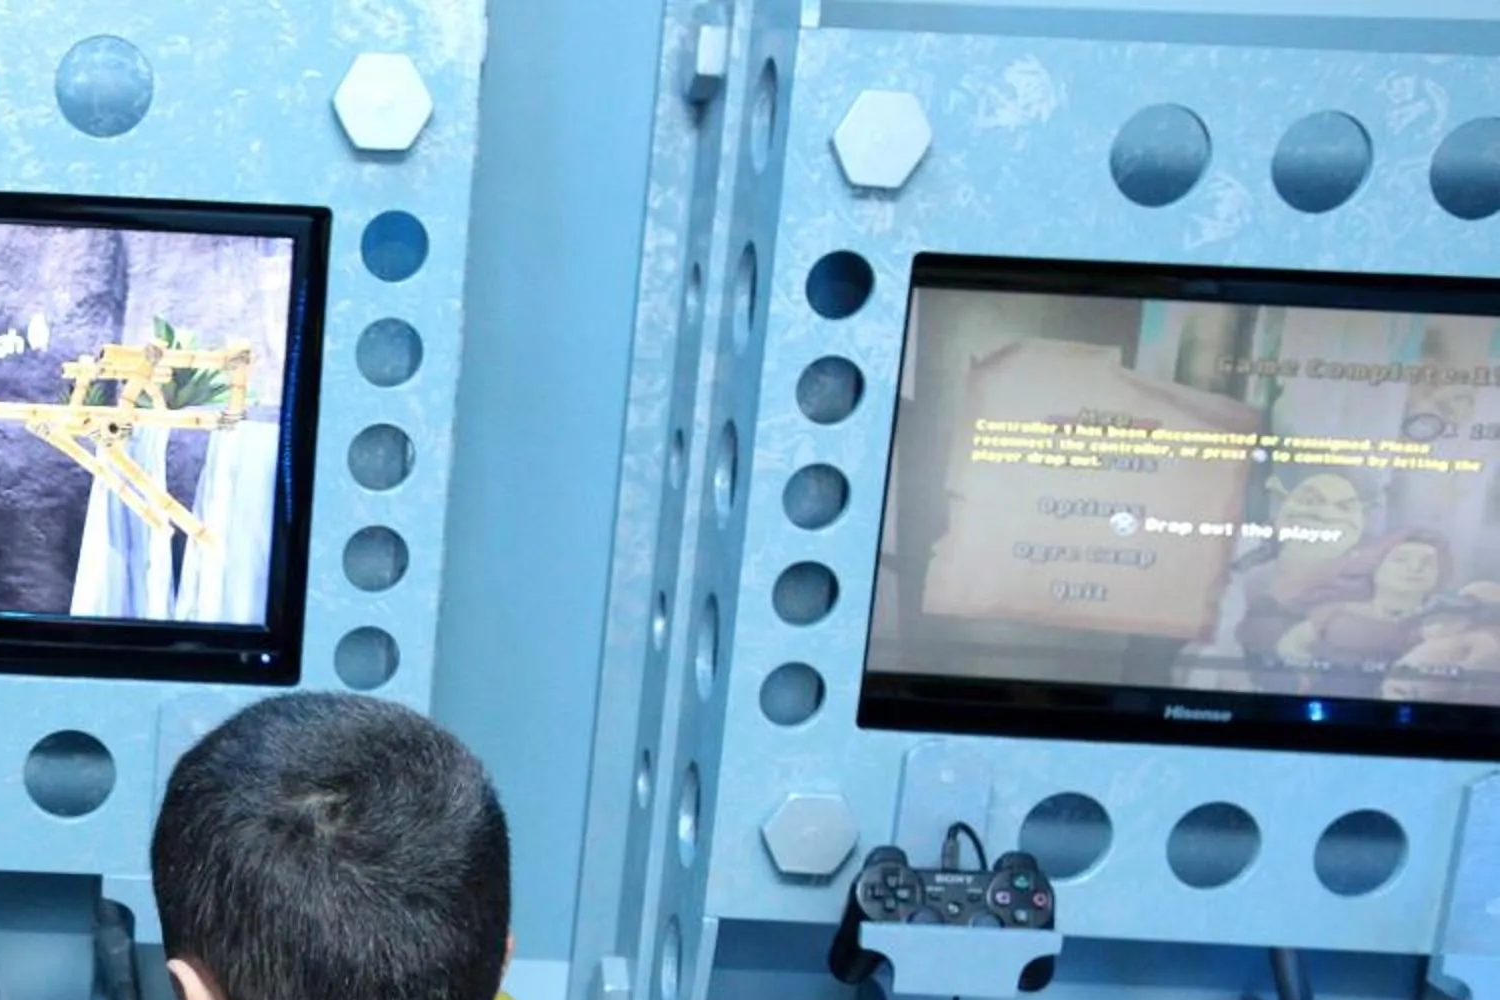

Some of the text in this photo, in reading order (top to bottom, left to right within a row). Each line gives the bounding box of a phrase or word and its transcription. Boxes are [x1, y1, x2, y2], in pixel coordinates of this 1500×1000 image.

[1144, 516, 1342, 543] Drop out the player
[1164, 704, 1233, 723] Hisense
[935, 873, 975, 885] SONY
